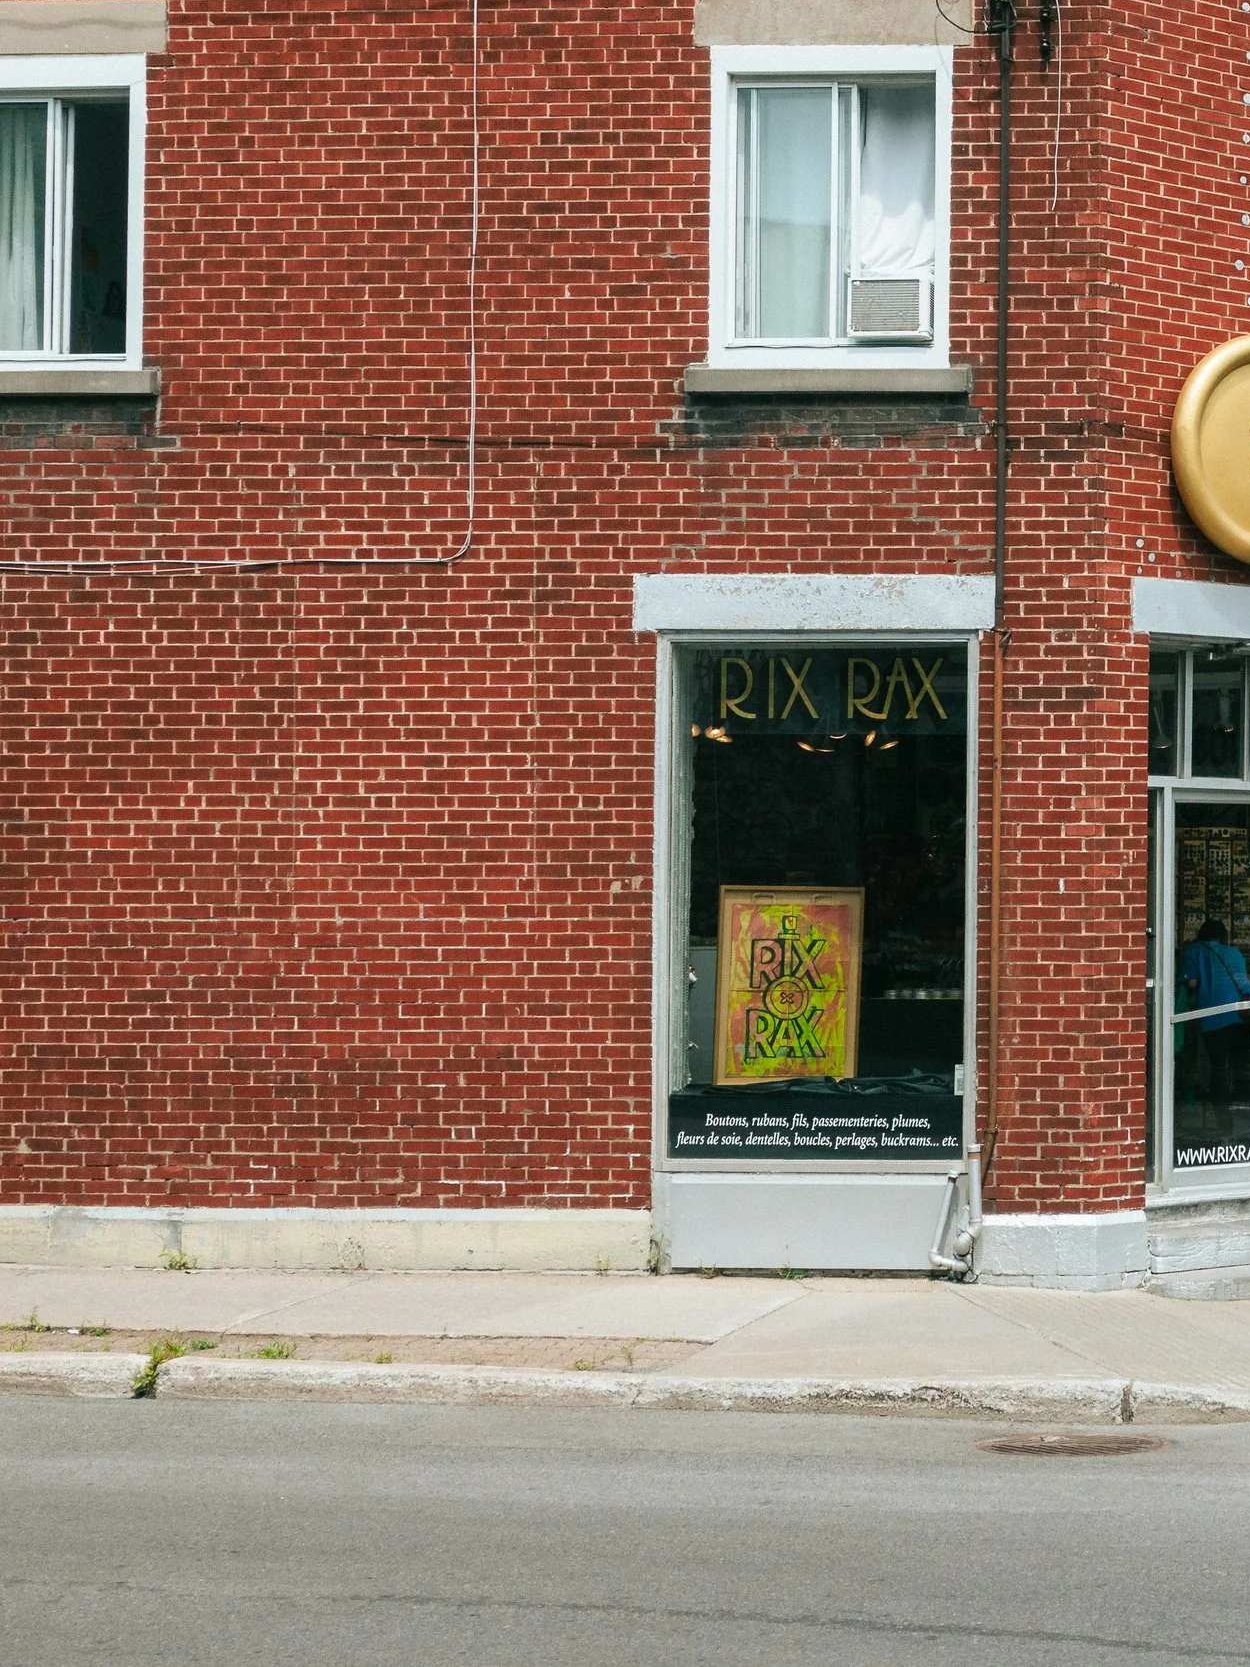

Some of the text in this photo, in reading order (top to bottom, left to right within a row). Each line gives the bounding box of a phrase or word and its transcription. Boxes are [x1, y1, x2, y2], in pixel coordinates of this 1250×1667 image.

[720, 657, 949, 721] RIX RAX
[750, 939, 827, 989] RIX
[745, 1008, 826, 1059] RAX
[675, 1131, 959, 1150] fleurs de soie, dentelles, boucles, perlages, buckrams... etc.
[705, 1113, 931, 1131] Boutons, rubans, fils, passementeries, plumes,
